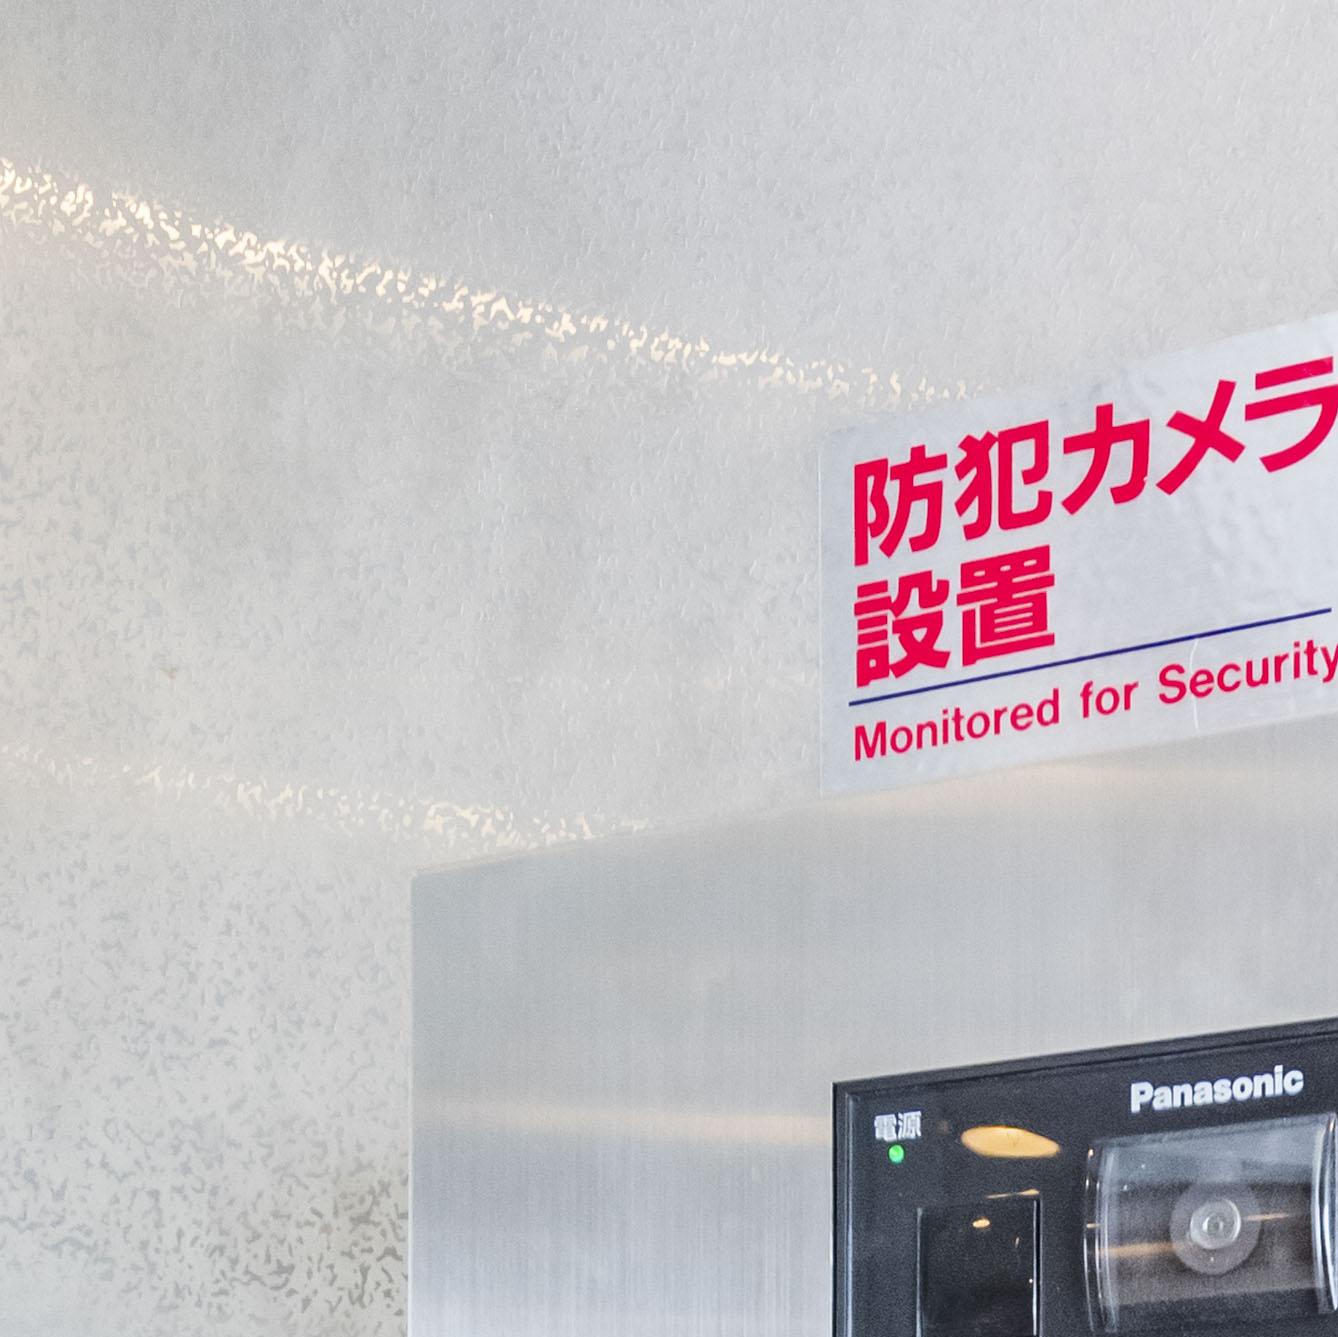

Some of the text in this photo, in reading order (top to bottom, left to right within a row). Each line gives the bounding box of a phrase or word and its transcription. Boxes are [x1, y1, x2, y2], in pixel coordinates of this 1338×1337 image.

[853, 543, 1056, 688] 設置
[854, 689, 1060, 761] Monitored
[1080, 679, 1139, 718] for
[1129, 1064, 1305, 1114] Panasonic
[874, 1110, 922, 1142] 電源
